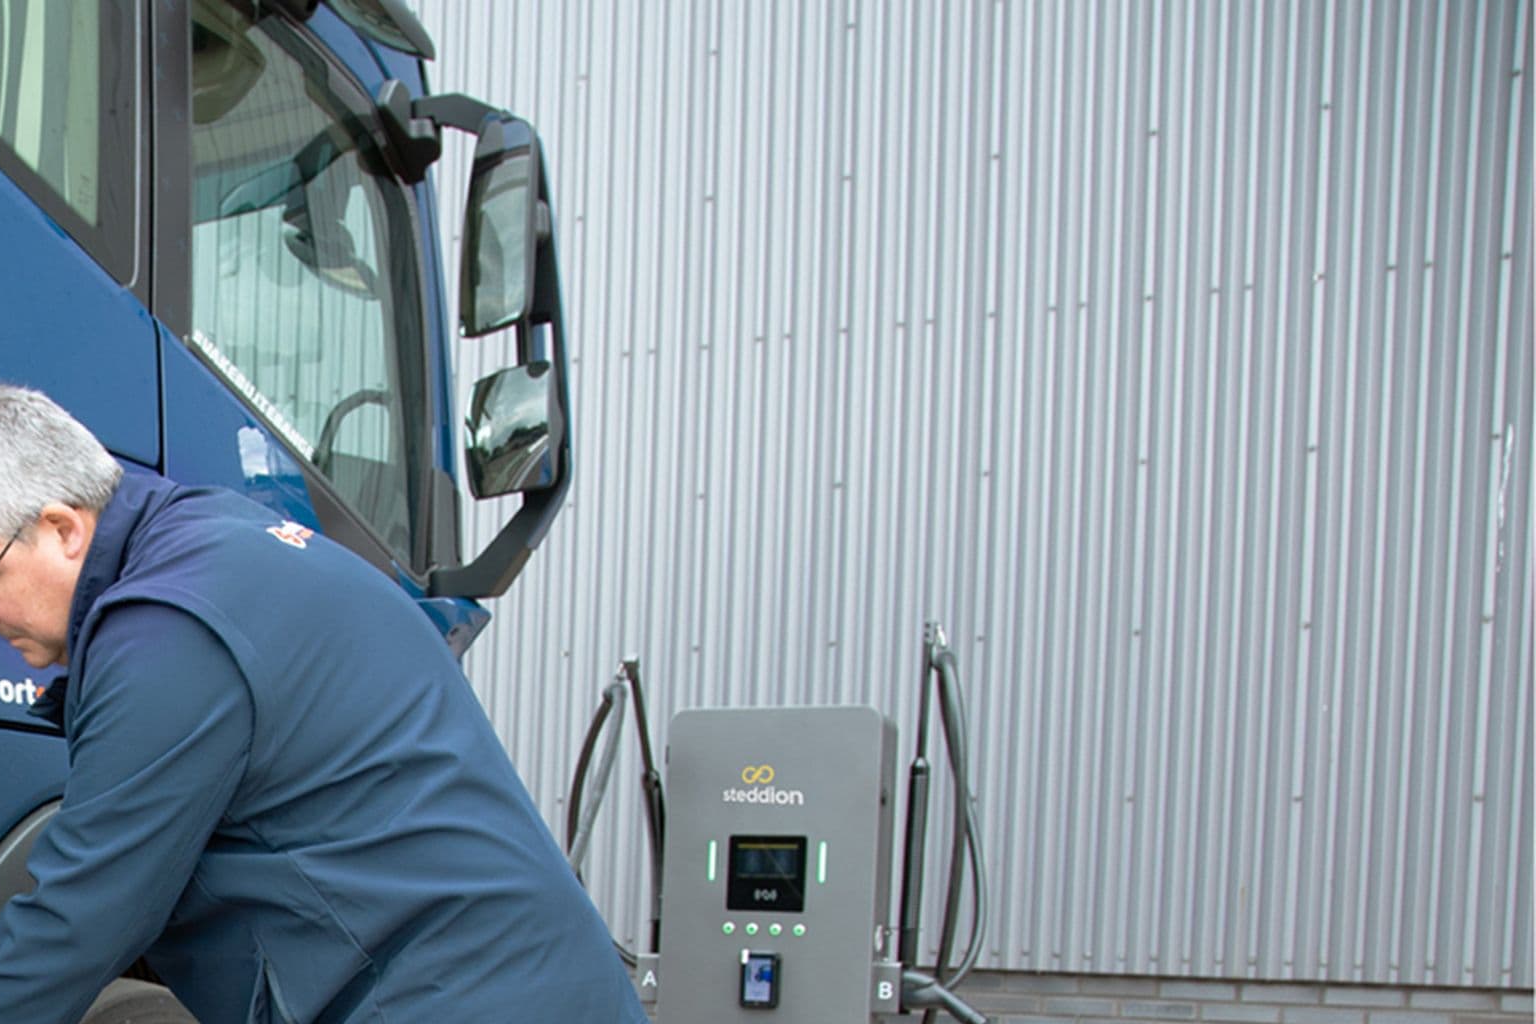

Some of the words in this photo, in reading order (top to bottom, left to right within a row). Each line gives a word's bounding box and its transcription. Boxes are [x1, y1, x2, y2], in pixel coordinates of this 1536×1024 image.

[723, 786, 804, 805] steddion
[642, 969, 657, 987] A
[878, 981, 893, 1000] B
